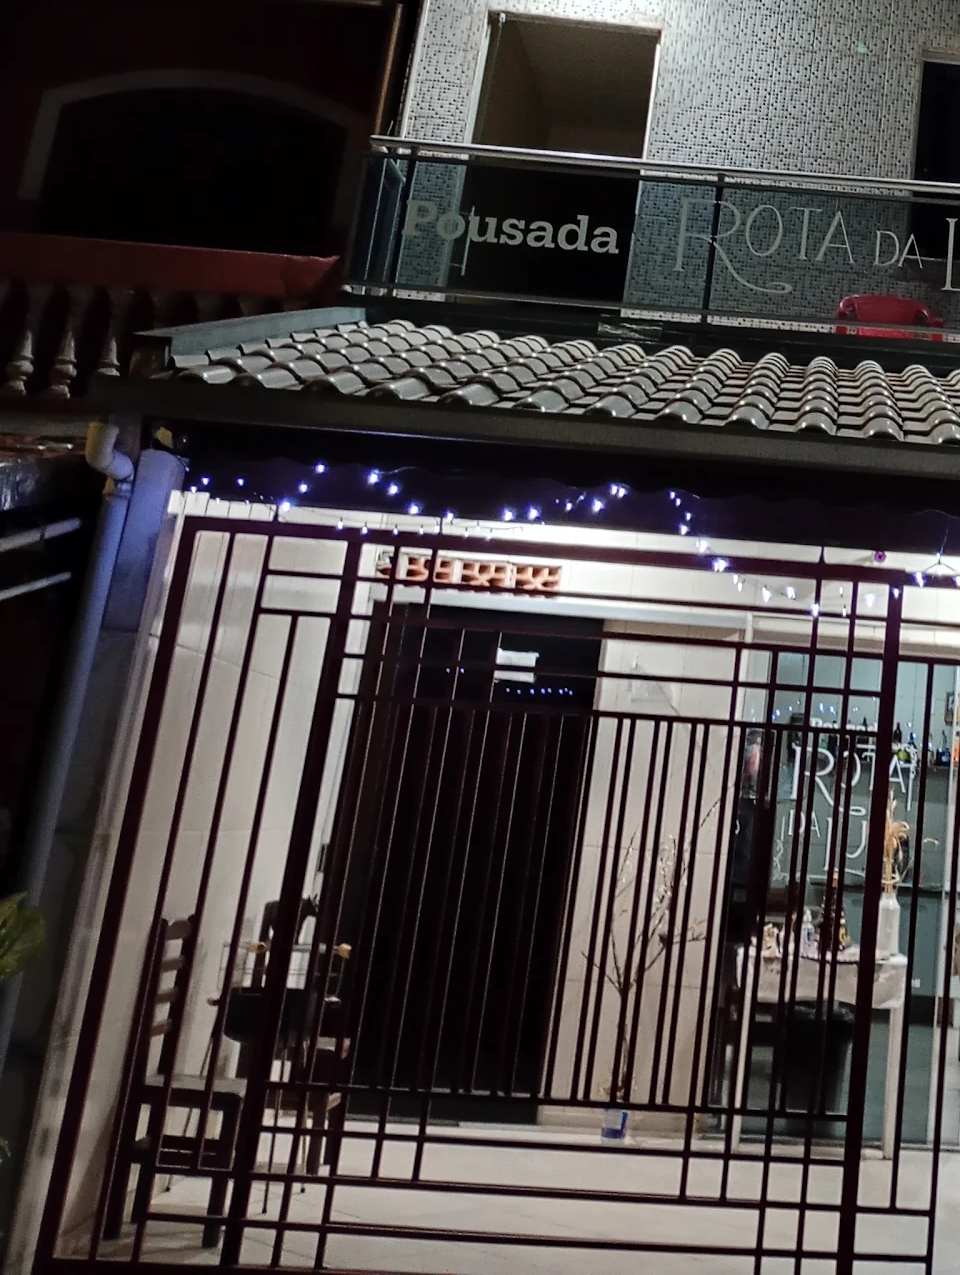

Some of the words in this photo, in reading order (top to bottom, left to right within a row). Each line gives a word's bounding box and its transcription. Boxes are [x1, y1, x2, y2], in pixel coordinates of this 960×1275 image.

[401, 198, 620, 255] Pousada
[673, 197, 855, 295] ROTA
[873, 229, 924, 269] DA
